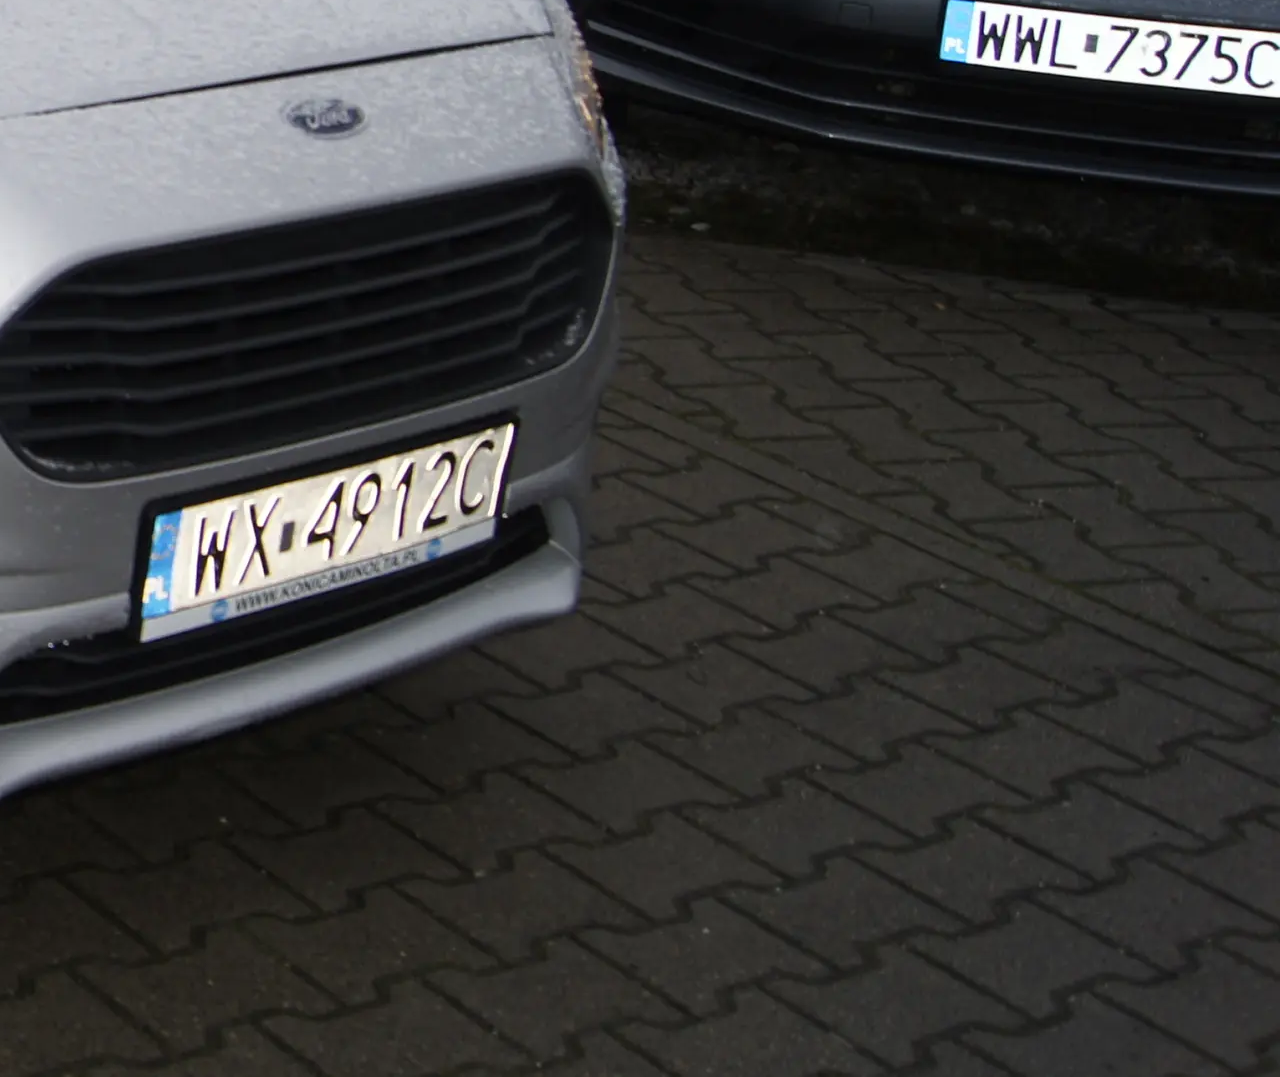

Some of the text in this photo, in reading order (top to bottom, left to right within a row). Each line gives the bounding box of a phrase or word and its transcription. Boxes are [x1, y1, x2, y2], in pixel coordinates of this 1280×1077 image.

[943, 36, 966, 54] PL
[976, 10, 1280, 89] WWL 7375C
[194, 438, 495, 598] WX 4912C
[143, 575, 169, 604] PL
